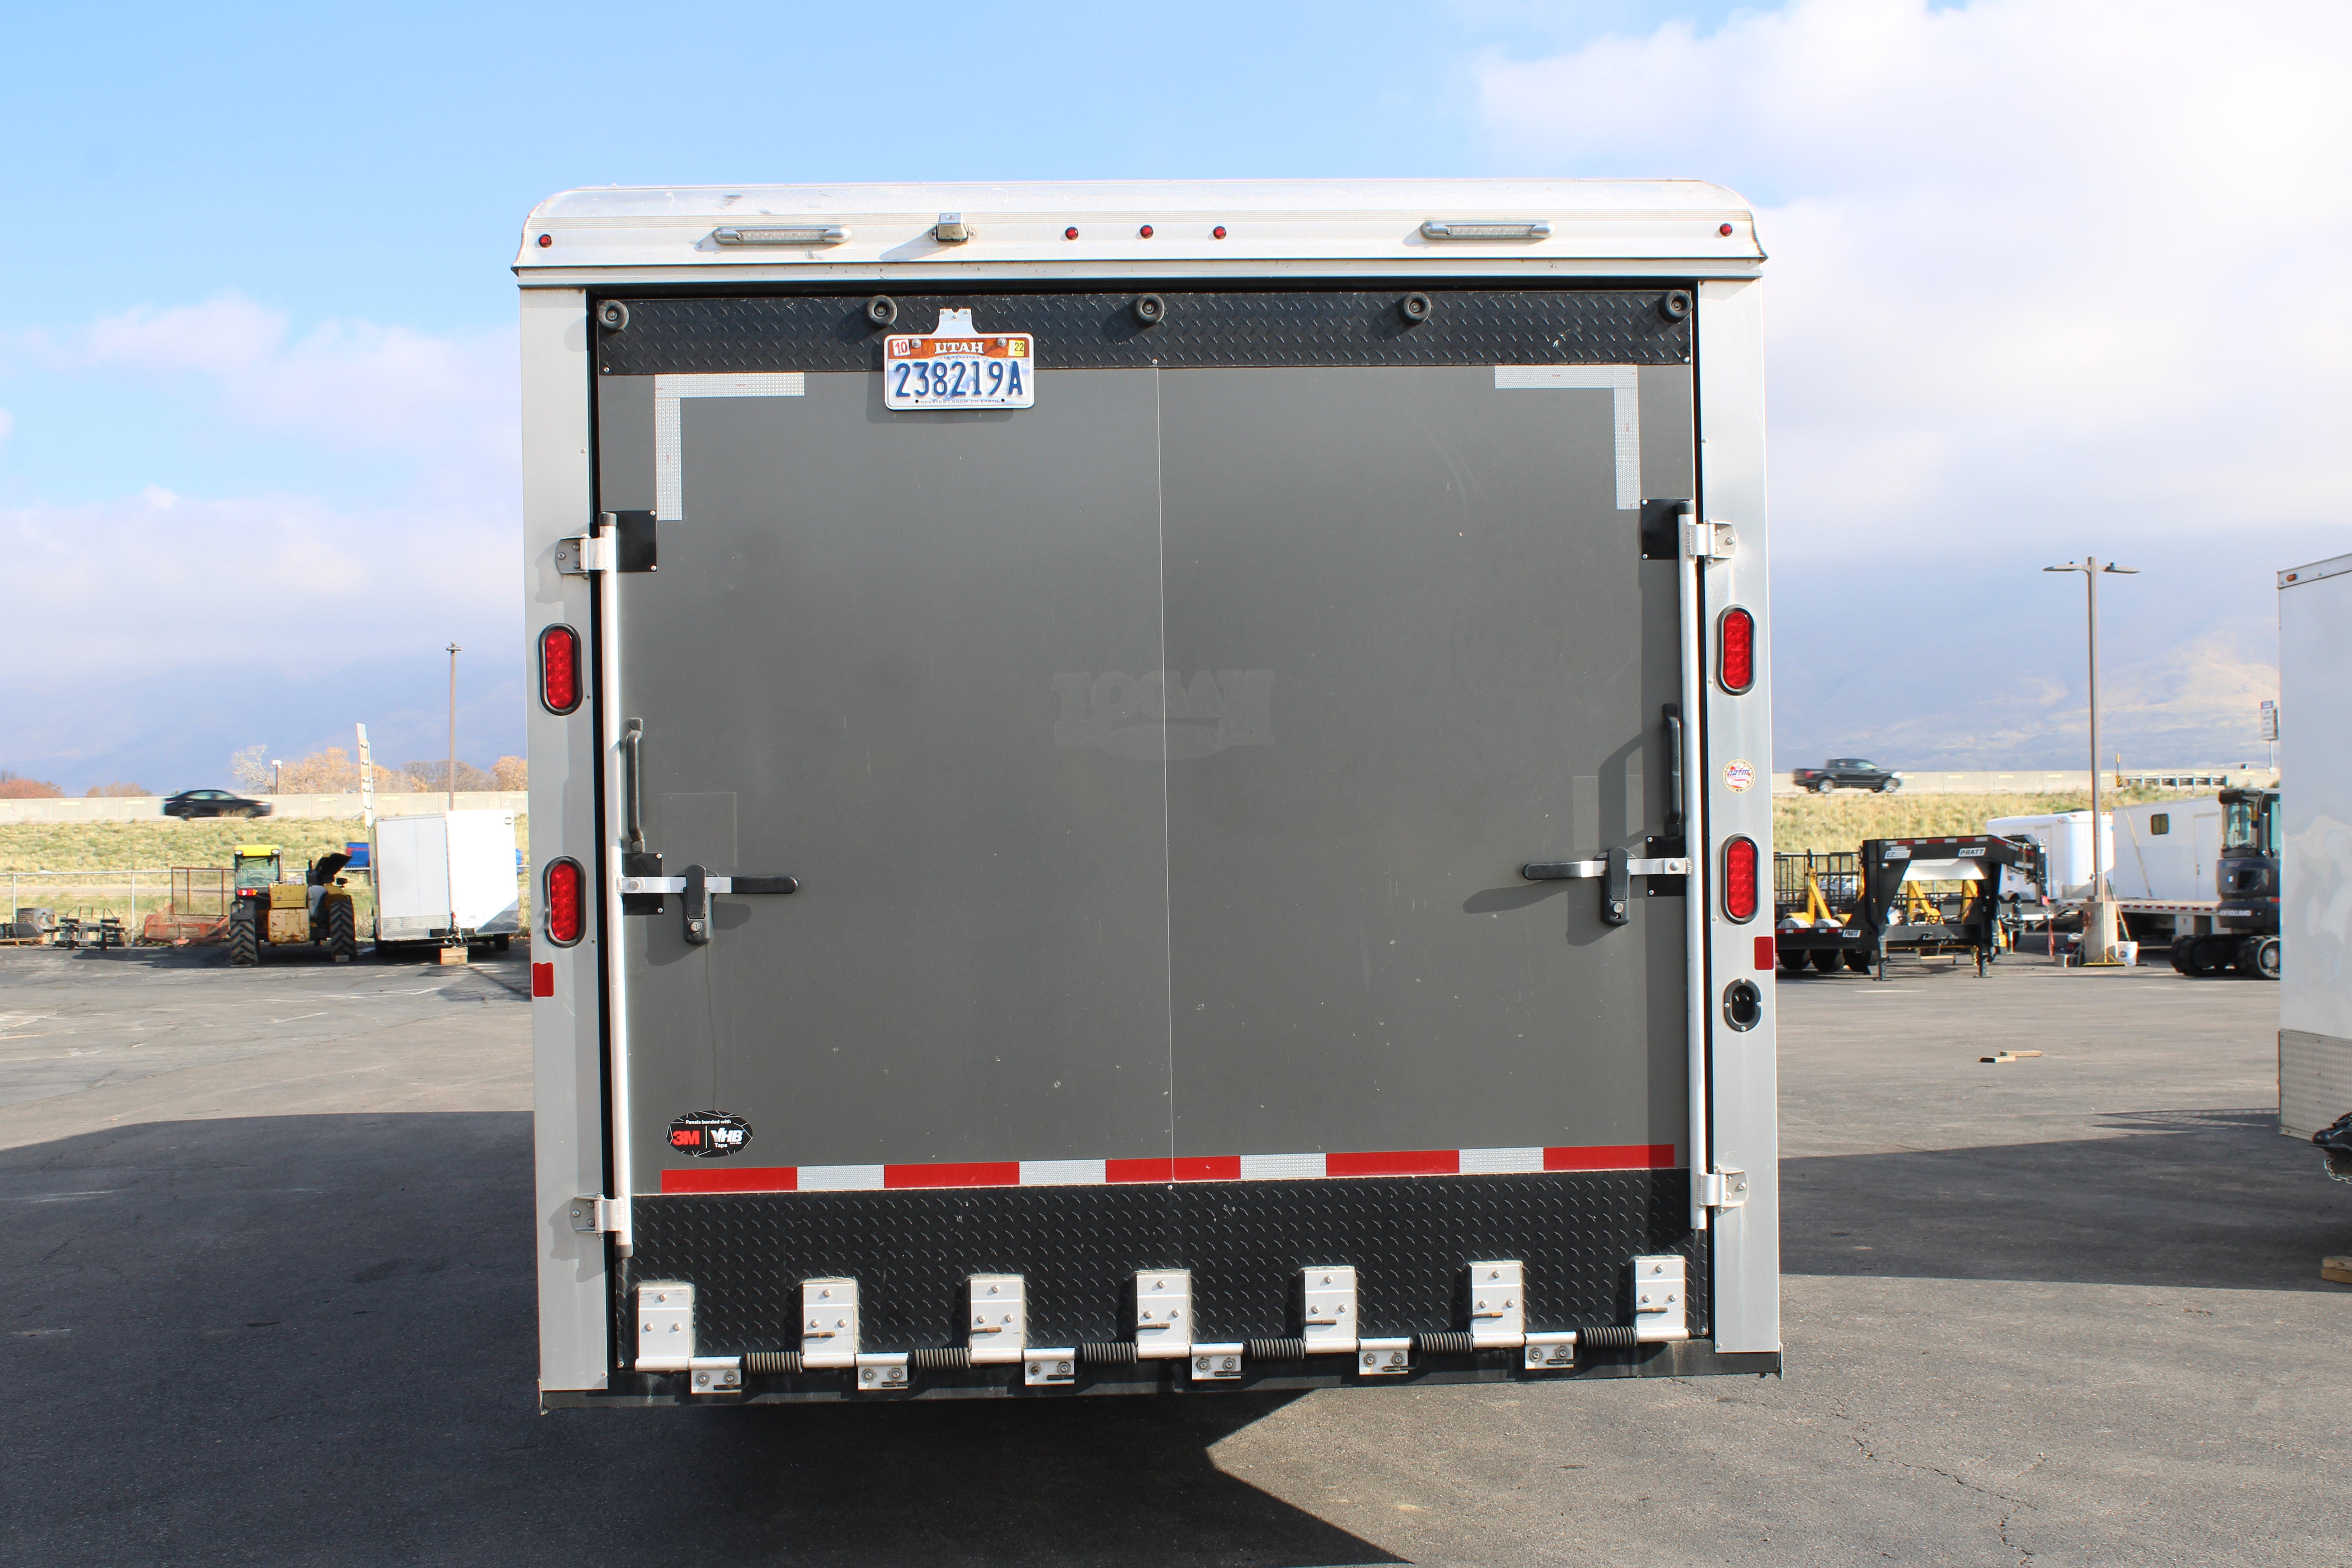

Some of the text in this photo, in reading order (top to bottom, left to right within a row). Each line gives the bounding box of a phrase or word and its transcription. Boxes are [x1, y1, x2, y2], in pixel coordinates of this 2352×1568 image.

[895, 341, 908, 354] 10
[934, 342, 984, 354] UTAH
[1014, 342, 1024, 352] 22
[895, 361, 1023, 397] 238219A
[672, 1127, 743, 1145] 3M VHB
